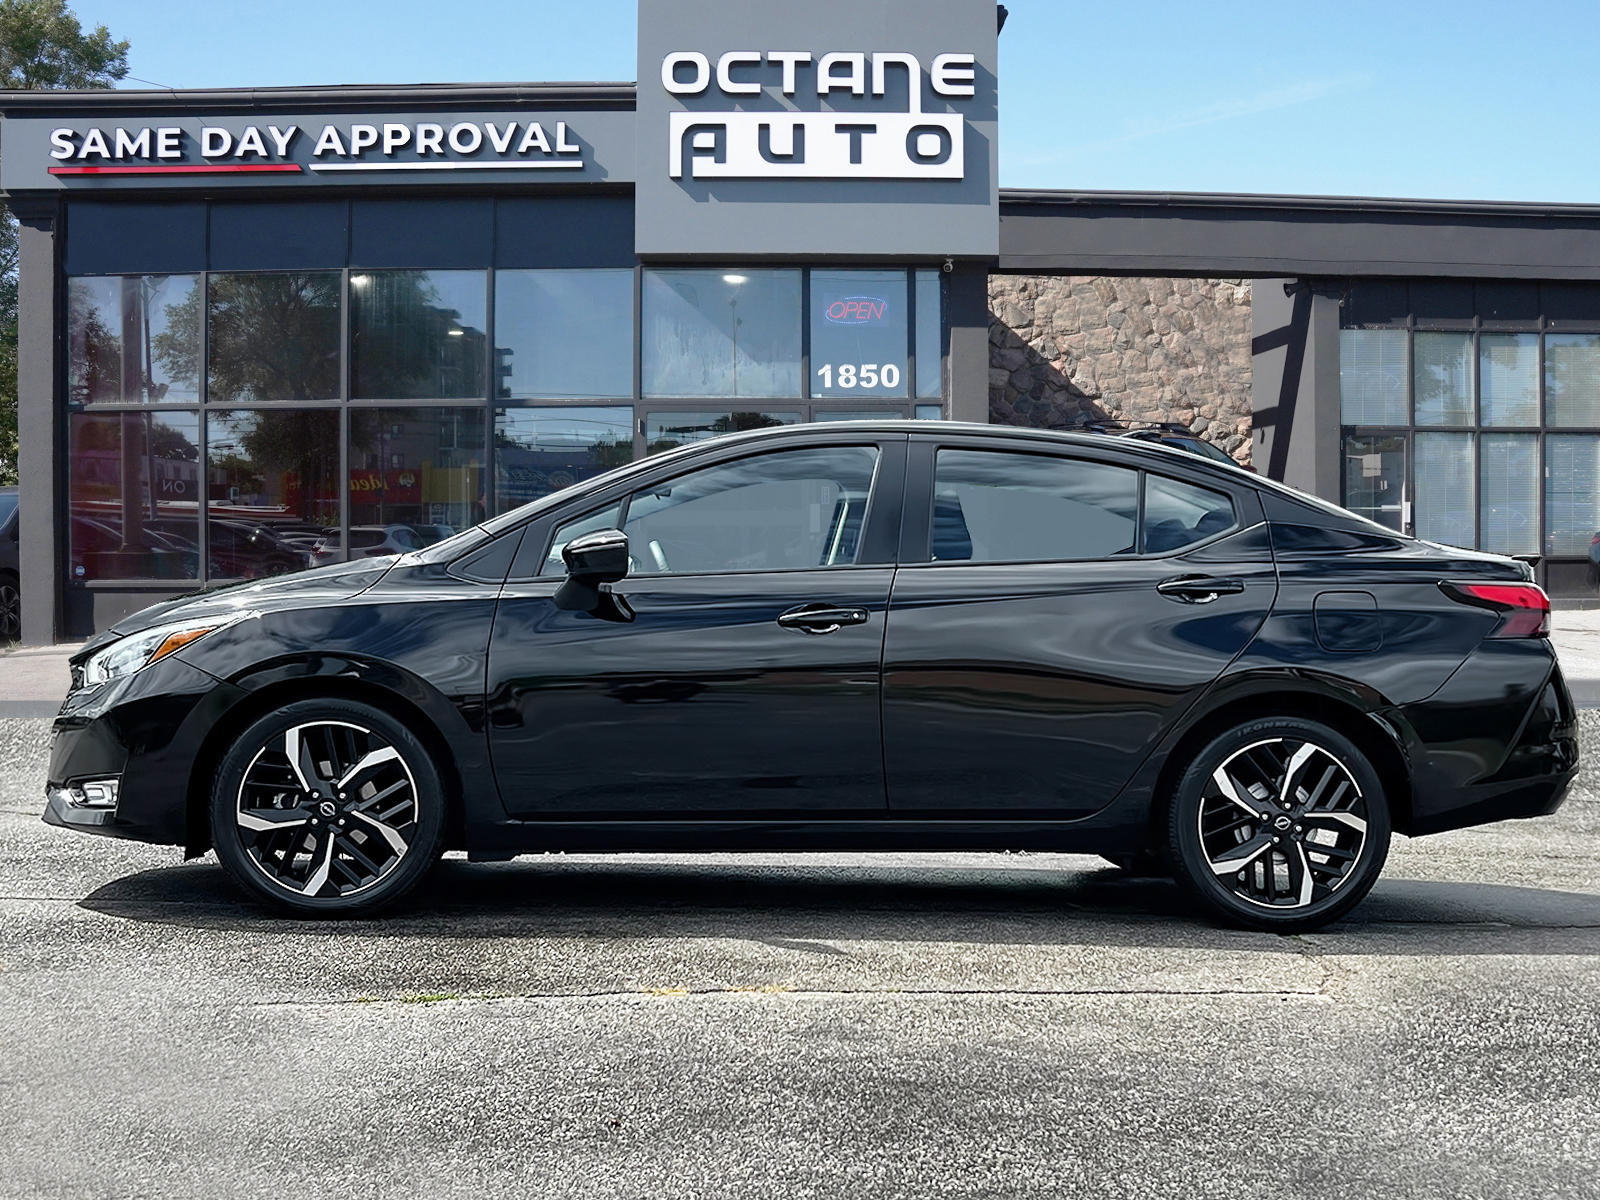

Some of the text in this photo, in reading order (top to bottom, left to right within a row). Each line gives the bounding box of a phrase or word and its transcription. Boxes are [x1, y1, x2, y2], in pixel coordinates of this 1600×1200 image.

[661, 51, 975, 112] OCTANE
[49, 121, 580, 159] SAME DAY APPROVAL
[681, 123, 952, 176] AUTO
[829, 302, 885, 319] OPEN
[817, 364, 900, 388] 1850
[1237, 721, 1308, 737] IRONMAN
